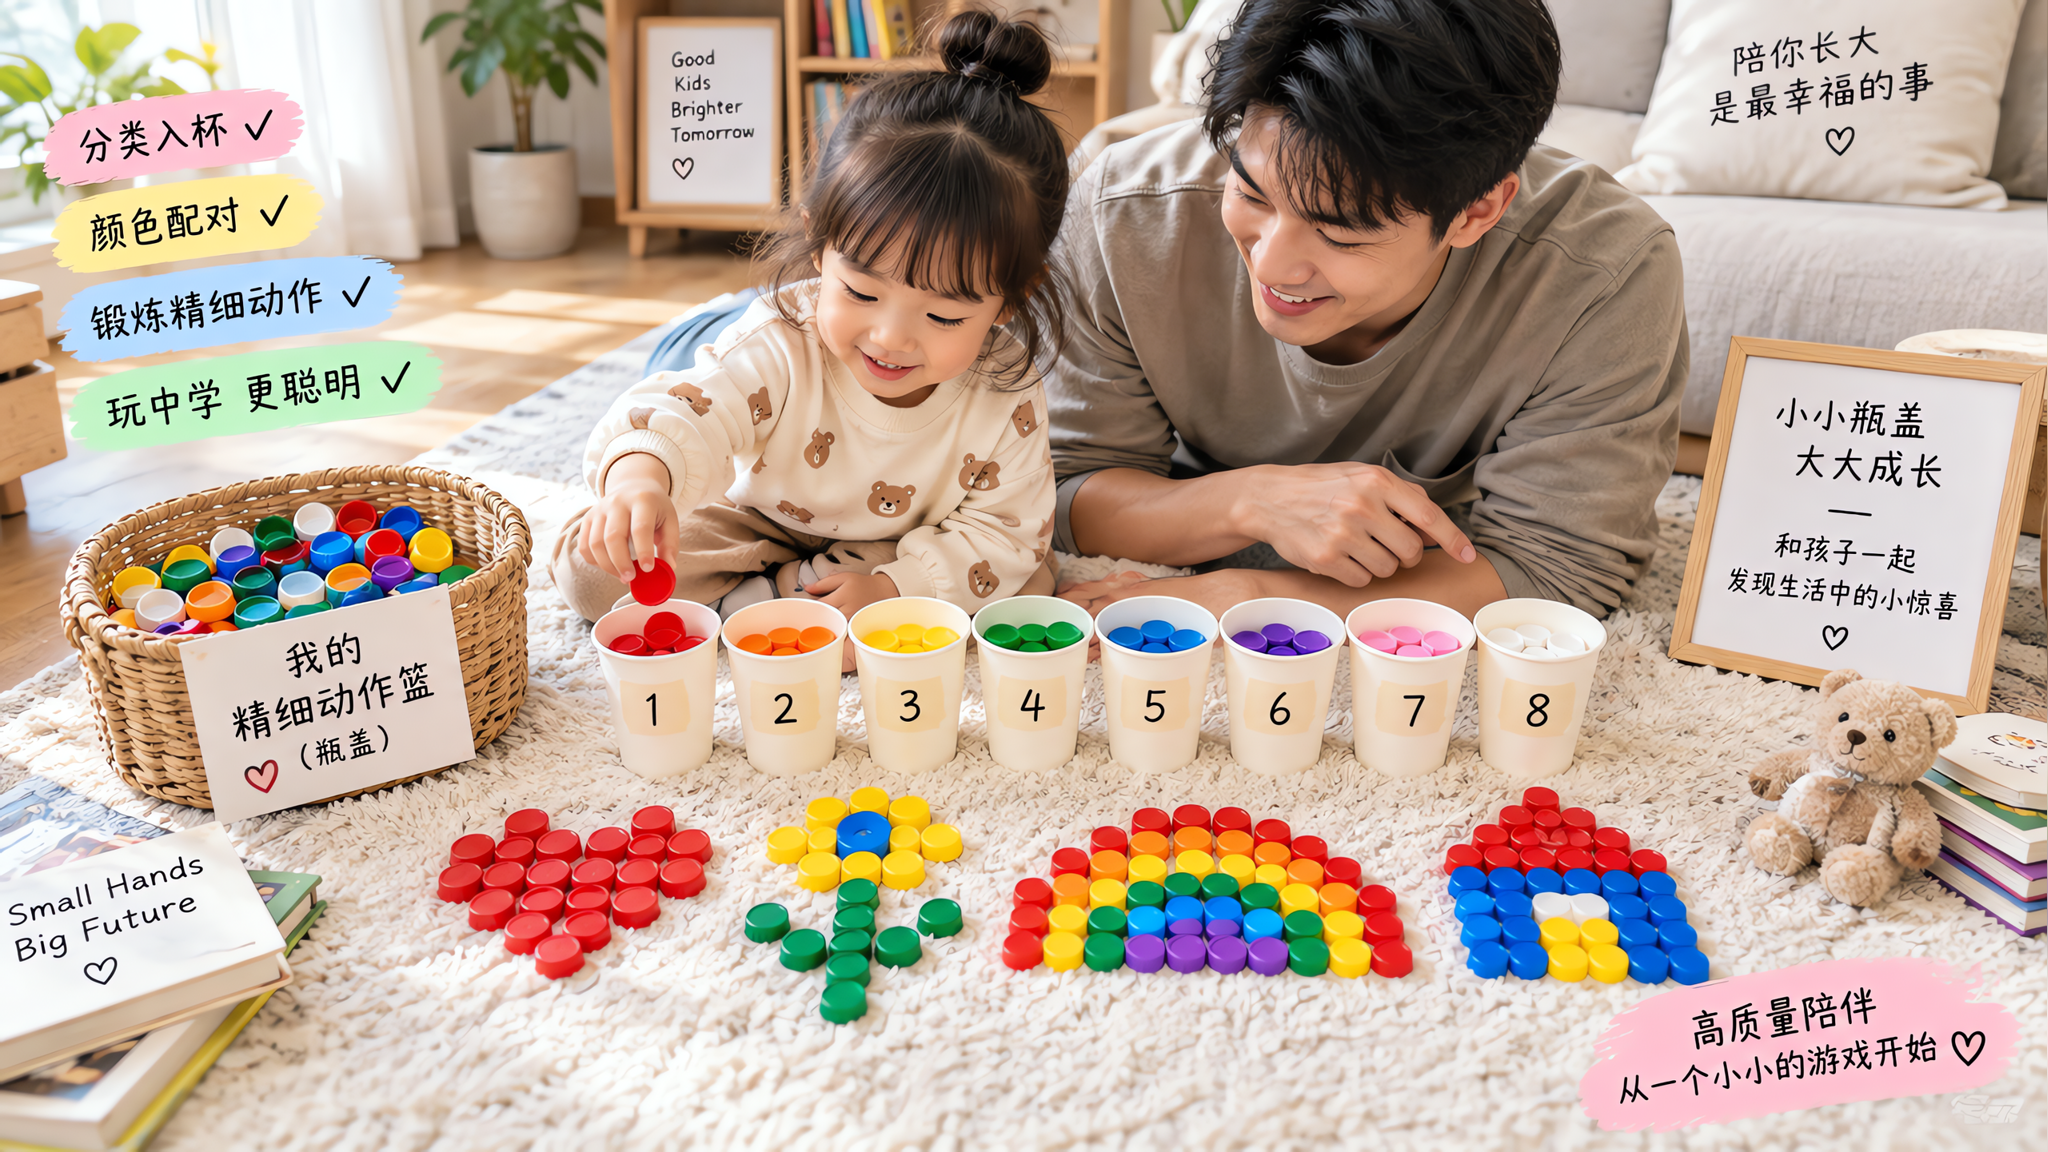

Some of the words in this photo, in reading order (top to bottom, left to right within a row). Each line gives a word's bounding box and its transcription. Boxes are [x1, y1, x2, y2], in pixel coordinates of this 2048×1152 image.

[671, 49, 715, 68] Good
[1733, 25, 1879, 77] 陪你长大
[675, 74, 711, 92] Kids
[1710, 61, 1934, 127] 是最幸福的事
[671, 100, 742, 122] Brighter
[671, 126, 755, 143] Tomorrow
[1776, 397, 1925, 439] 小小瓶盖
[1795, 444, 1942, 489] 大大成长
[1774, 532, 1916, 574] 和孩子一起
[1727, 567, 1959, 621] 发现生活中的小惊喜
[285, 632, 361, 679] 我的
[232, 662, 435, 742] 精细动作篮
[645, 692, 657, 727] 1
[774, 693, 798, 725] 2
[899, 689, 921, 723] 3
[1020, 688, 1046, 722] 4
[1144, 689, 1167, 723] 5
[1269, 691, 1291, 726] 6
[1403, 694, 1426, 728] 7
[1526, 693, 1550, 728] 8
[8, 883, 92, 926] Small
[106, 856, 204, 899] Hands
[14, 934, 68, 962] Big
[81, 897, 197, 942] Future
